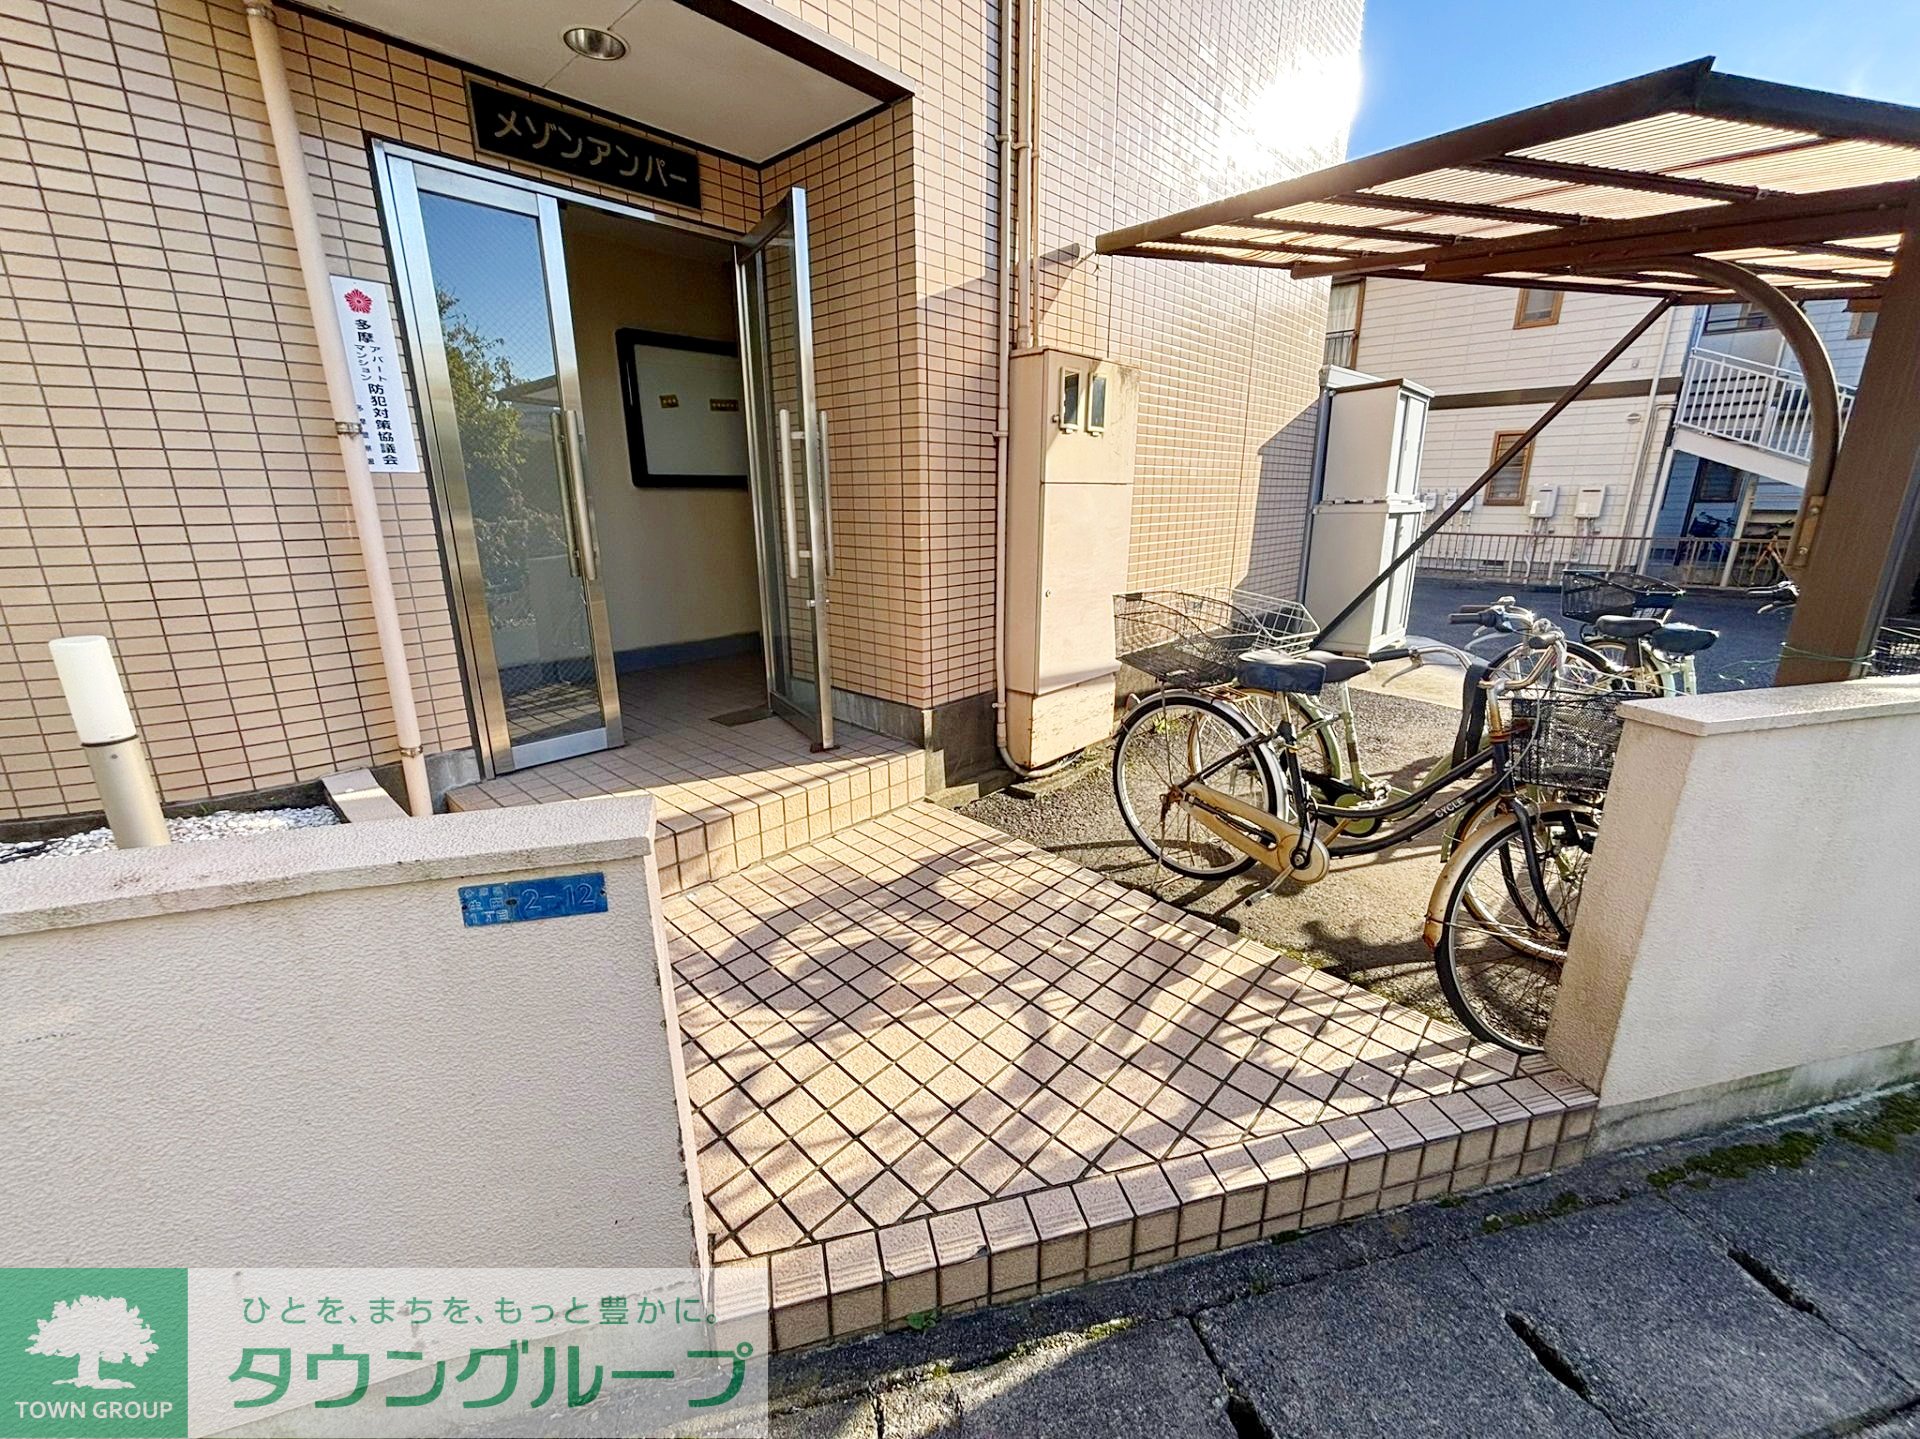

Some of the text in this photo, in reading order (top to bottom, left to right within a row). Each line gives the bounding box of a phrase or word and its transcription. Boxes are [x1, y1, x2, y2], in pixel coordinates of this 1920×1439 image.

[495, 111, 687, 187] メゾンアンパー
[355, 319, 375, 343] 多摩
[354, 344, 373, 382] マンション
[369, 345, 388, 382] アパート
[368, 384, 399, 466] 防犯対策協議会
[1435, 797, 1466, 818] CYCLE
[521, 882, 596, 911] 2-12
